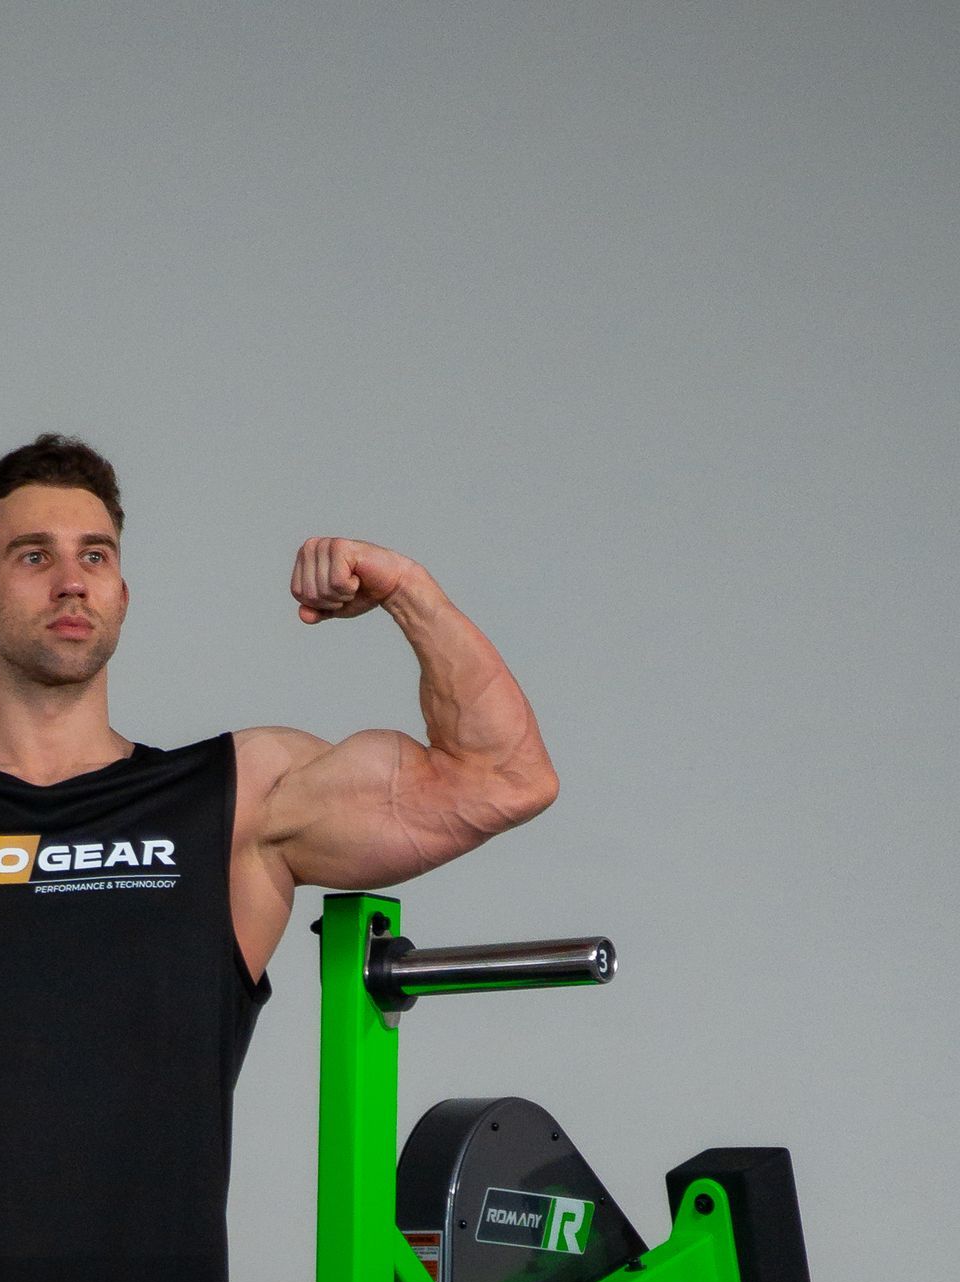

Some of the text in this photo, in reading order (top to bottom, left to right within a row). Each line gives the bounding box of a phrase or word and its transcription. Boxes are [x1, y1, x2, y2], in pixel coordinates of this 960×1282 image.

[35, 879, 176, 894] PERFORMANCE & TECHNOLOGY
[599, 949, 608, 973] 3
